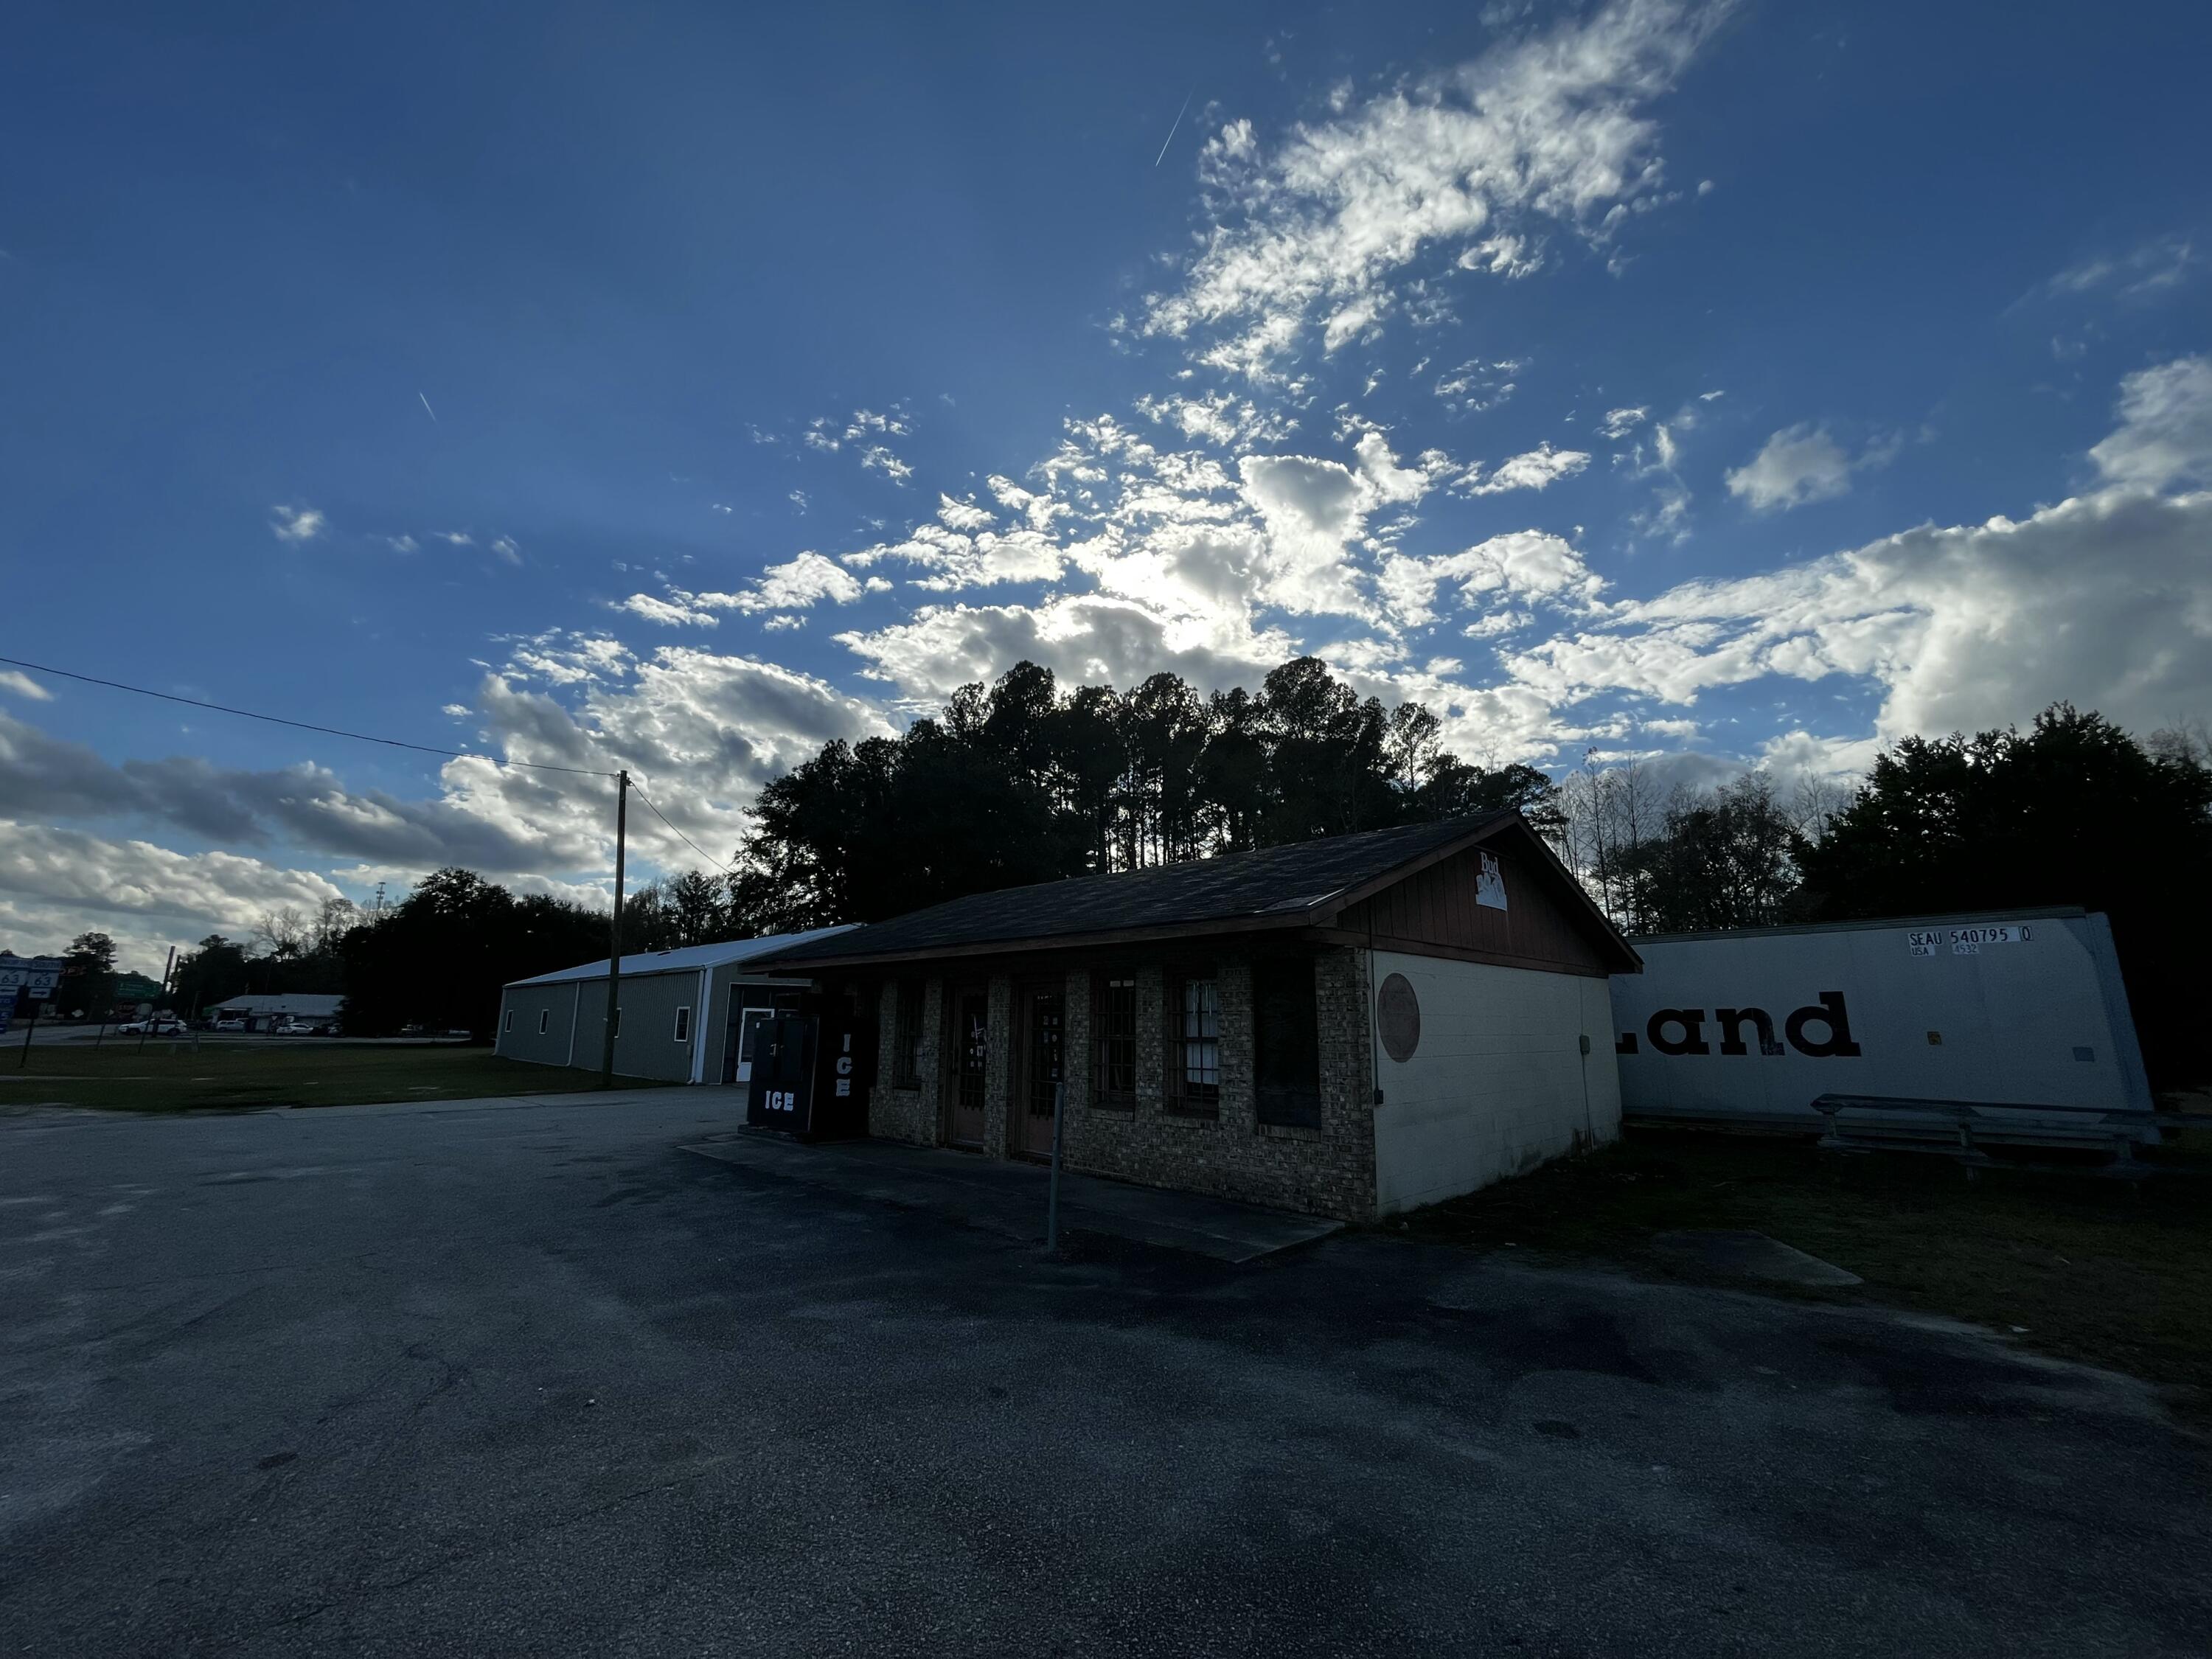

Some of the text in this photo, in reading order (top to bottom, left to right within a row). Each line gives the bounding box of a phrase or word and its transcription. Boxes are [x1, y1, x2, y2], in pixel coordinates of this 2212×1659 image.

[1481, 852, 1499, 874] Bud
[1910, 932, 1942, 945] SEAU
[1950, 928, 2008, 943] 540795
[1912, 947, 1929, 956] USA
[1, 975, 19, 984] 63
[35, 977, 51, 986] 63
[835, 1033, 853, 1097] ICE
[765, 1090, 795, 1112] ICE
